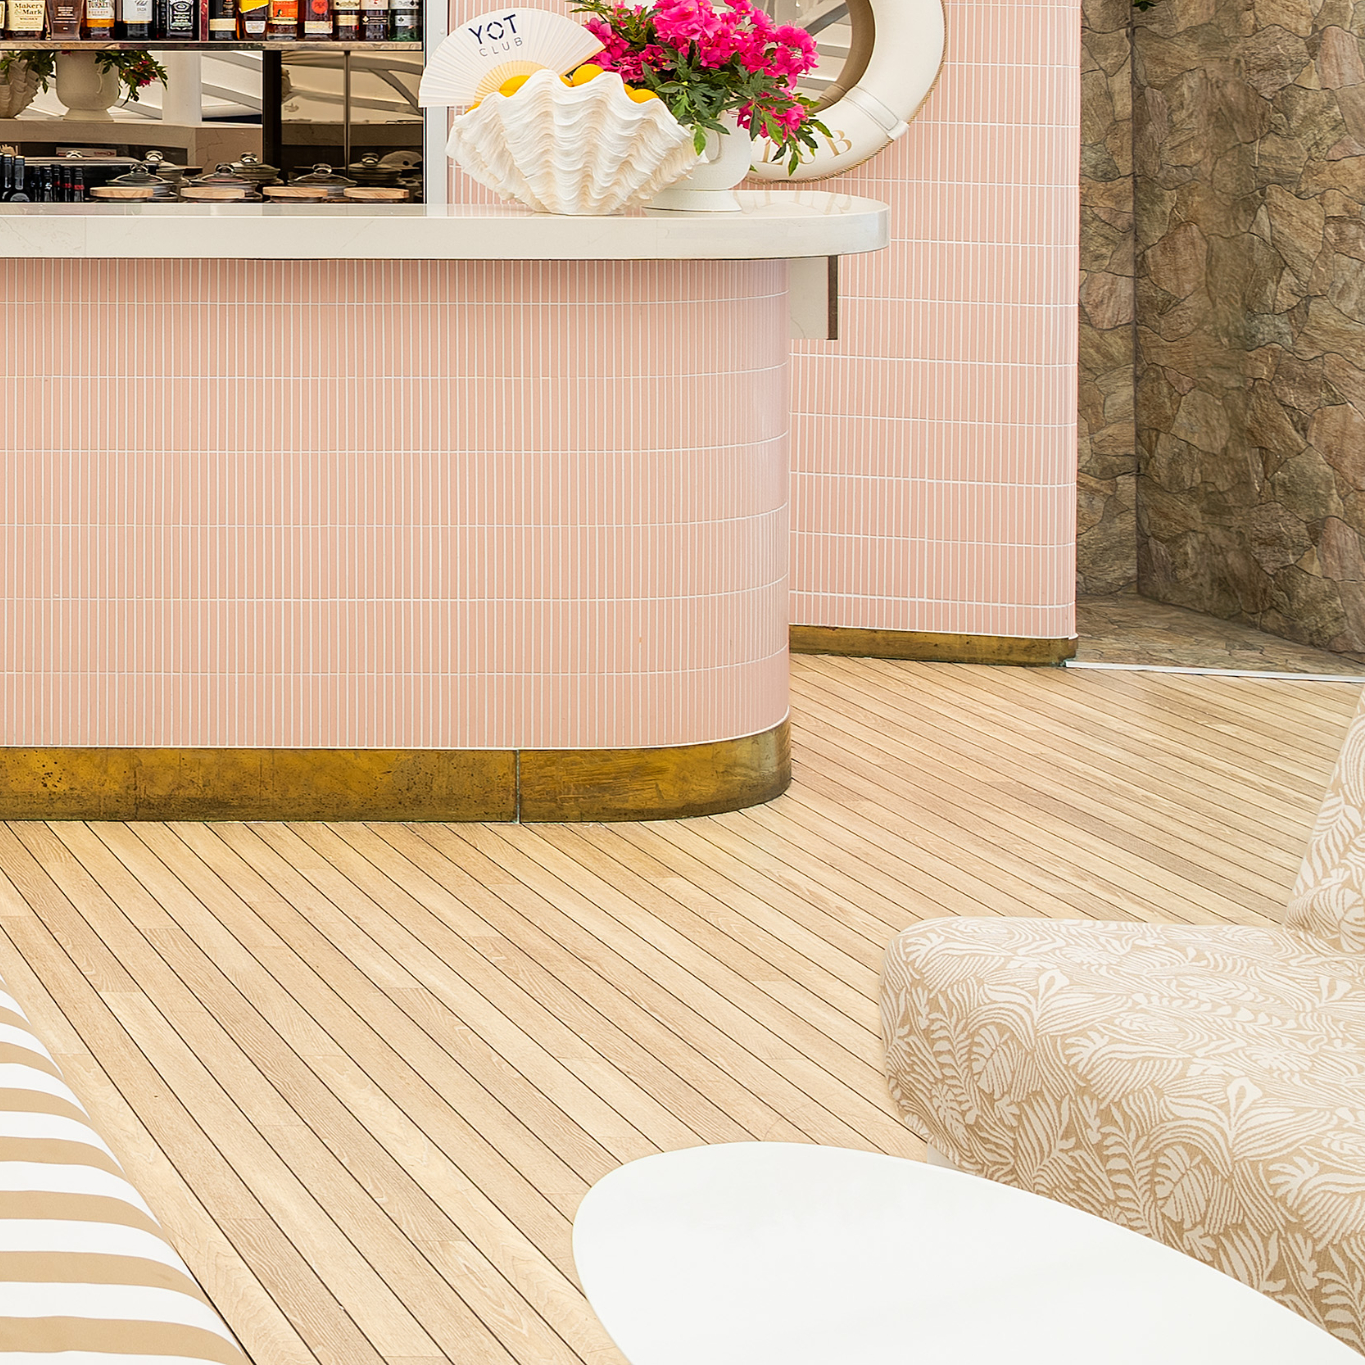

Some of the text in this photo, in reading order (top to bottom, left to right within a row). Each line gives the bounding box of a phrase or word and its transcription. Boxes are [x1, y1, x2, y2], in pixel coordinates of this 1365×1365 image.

[468, 13, 517, 45] YOT
[479, 37, 523, 57] CLUB
[753, 129, 853, 166] LUB
